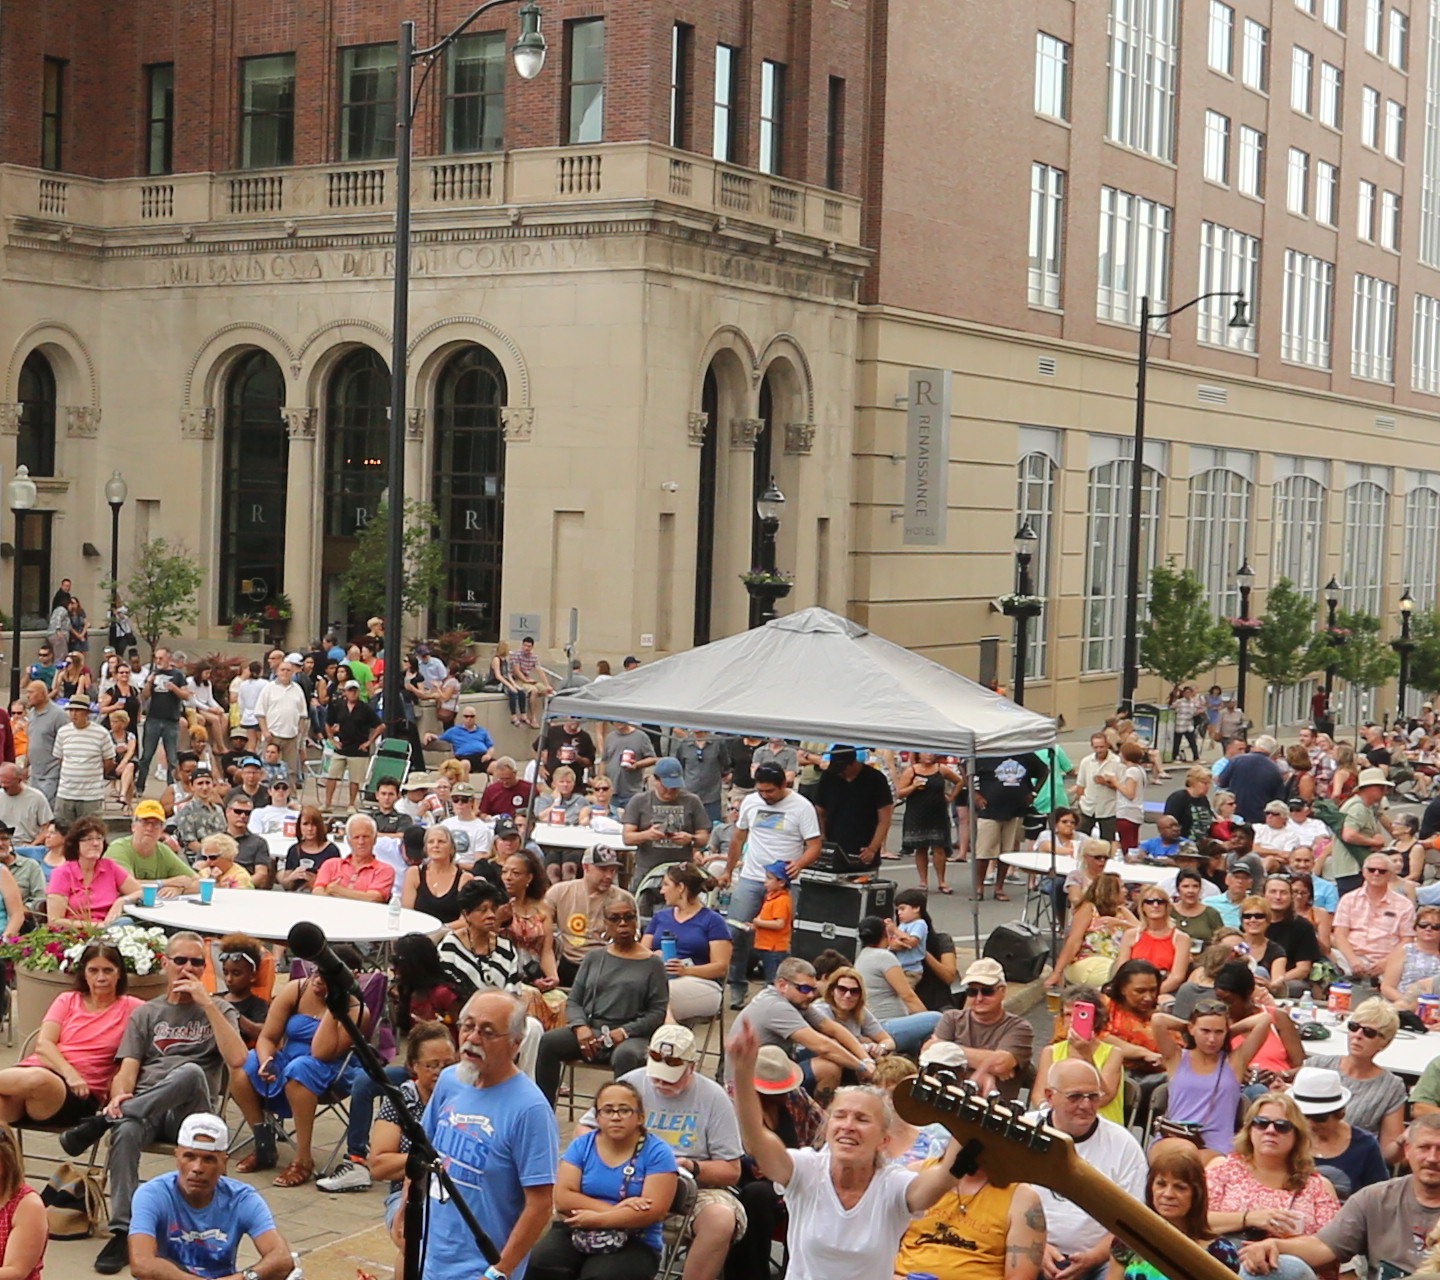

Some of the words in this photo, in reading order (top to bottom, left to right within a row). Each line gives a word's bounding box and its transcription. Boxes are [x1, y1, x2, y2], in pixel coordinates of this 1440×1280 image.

[456, 243, 583, 270] COMPANY
[915, 380, 941, 406] R
[915, 415, 931, 517] RENAISSANCE
[252, 504, 265, 523] R
[356, 507, 369, 528] R
[464, 509, 481, 531] R
[519, 617, 529, 629] R
